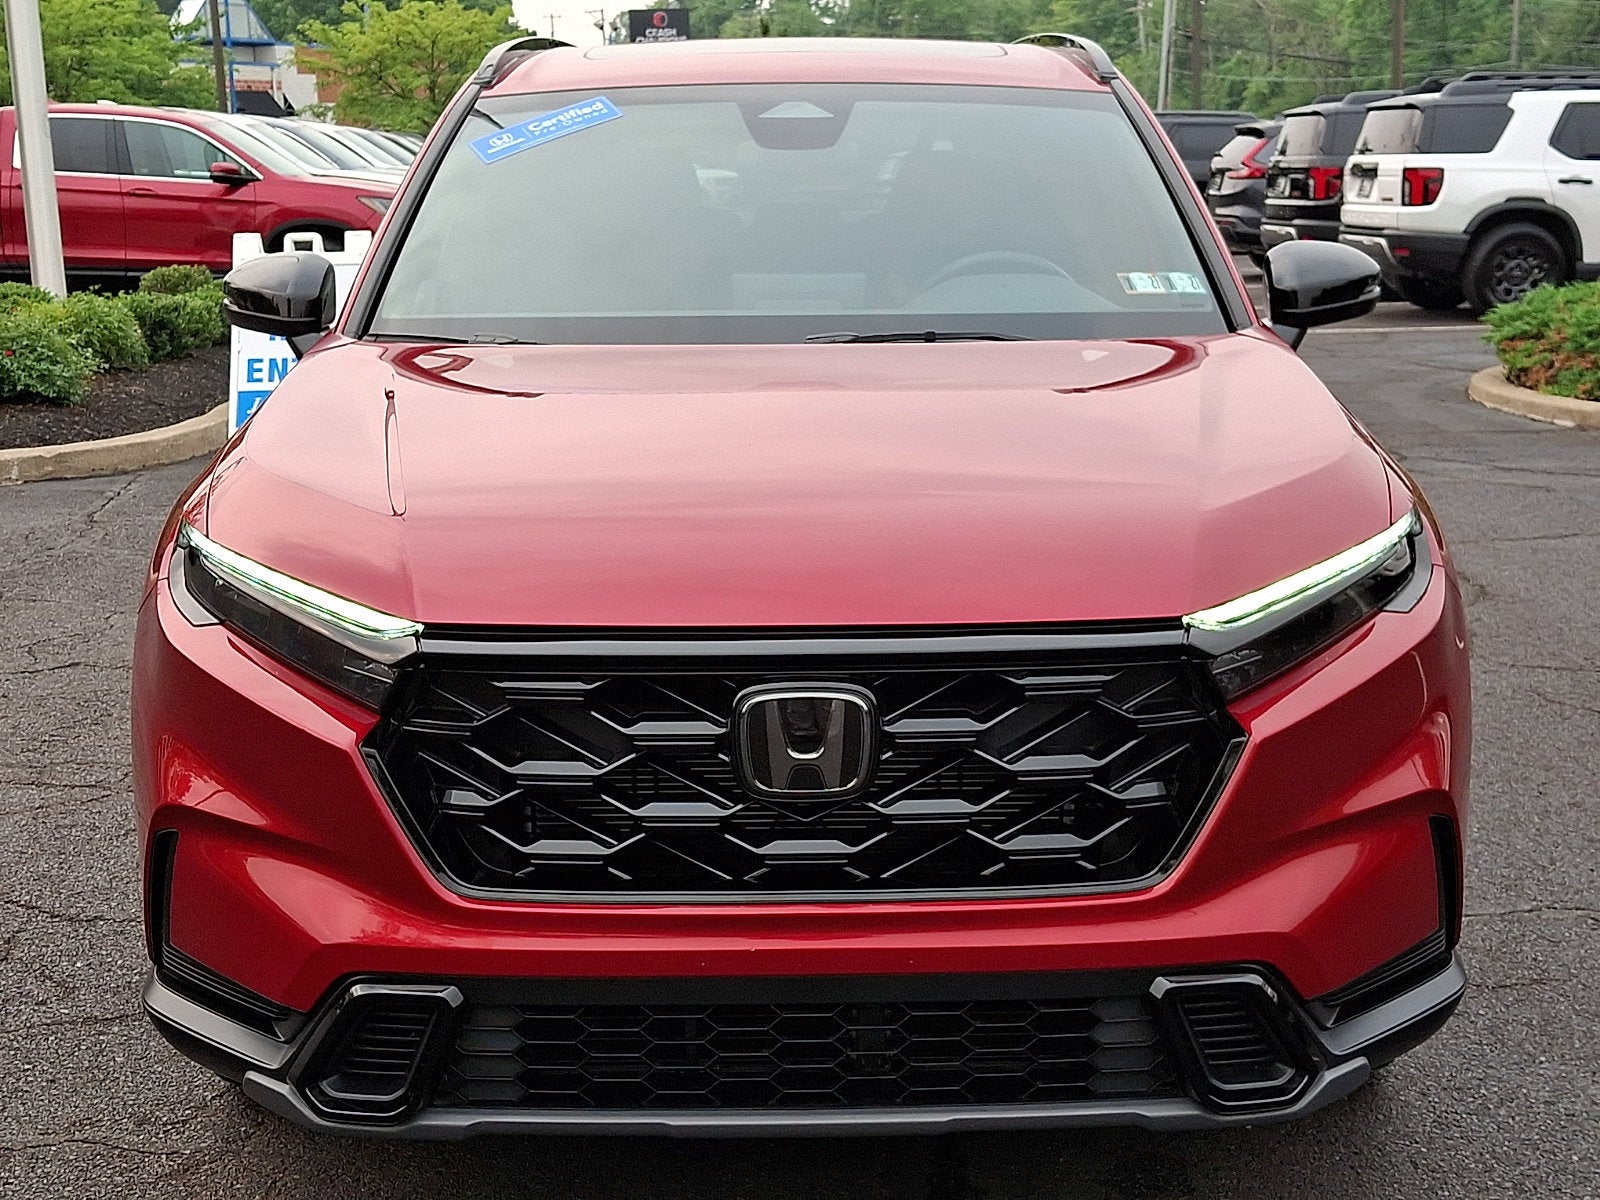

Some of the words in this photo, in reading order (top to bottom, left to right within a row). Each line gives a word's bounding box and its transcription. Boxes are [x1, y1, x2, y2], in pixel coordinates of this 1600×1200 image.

[528, 101, 604, 132] Certified
[534, 108, 609, 136] Pre-Owned
[246, 357, 299, 383] EN
